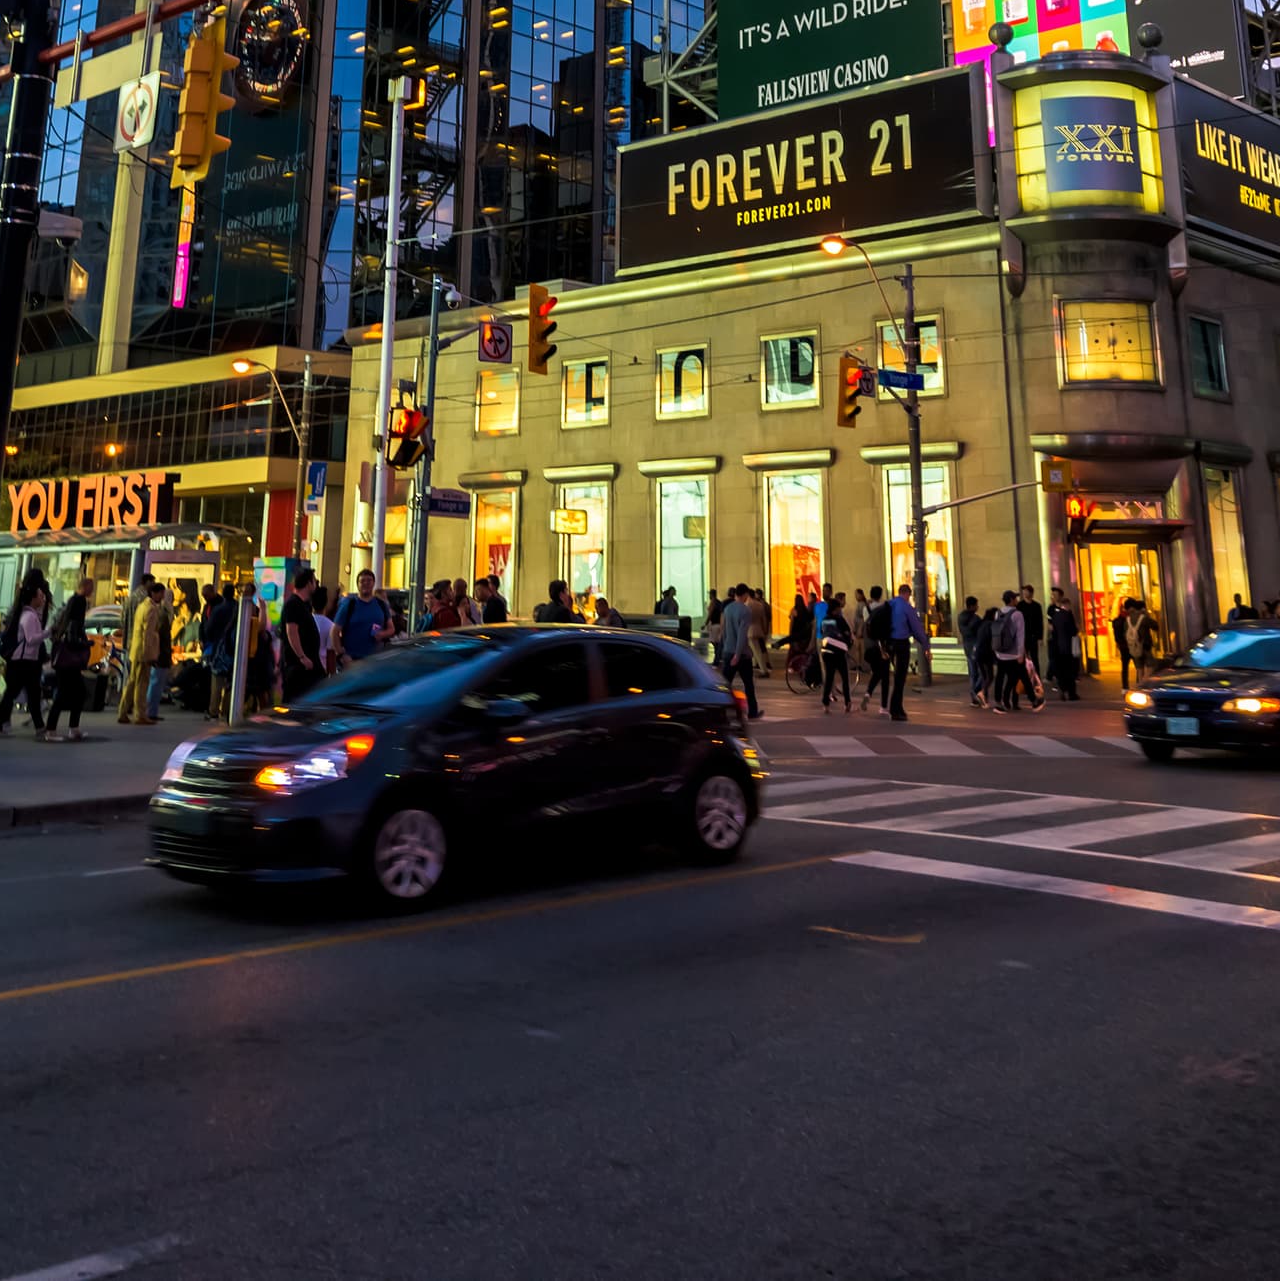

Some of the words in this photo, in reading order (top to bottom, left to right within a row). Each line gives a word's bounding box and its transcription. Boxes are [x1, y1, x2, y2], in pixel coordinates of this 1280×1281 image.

[738, 23, 773, 50] IT'S
[775, 19, 790, 40] A
[793, 1, 849, 35] WILD
[757, 65, 832, 108] FALLSVIEW
[833, 54, 890, 89] CASINO
[668, 128, 846, 215] FOREVER
[869, 113, 913, 176] 21
[1054, 124, 1133, 155] XXI
[1056, 153, 1134, 164] FOREVER
[1195, 118, 1229, 166] LIKE
[1229, 134, 1246, 174] IT.
[736, 194, 832, 227] FOREVER21.COM
[8, 481, 69, 533] YOU
[76, 473, 166, 530] FIRST
